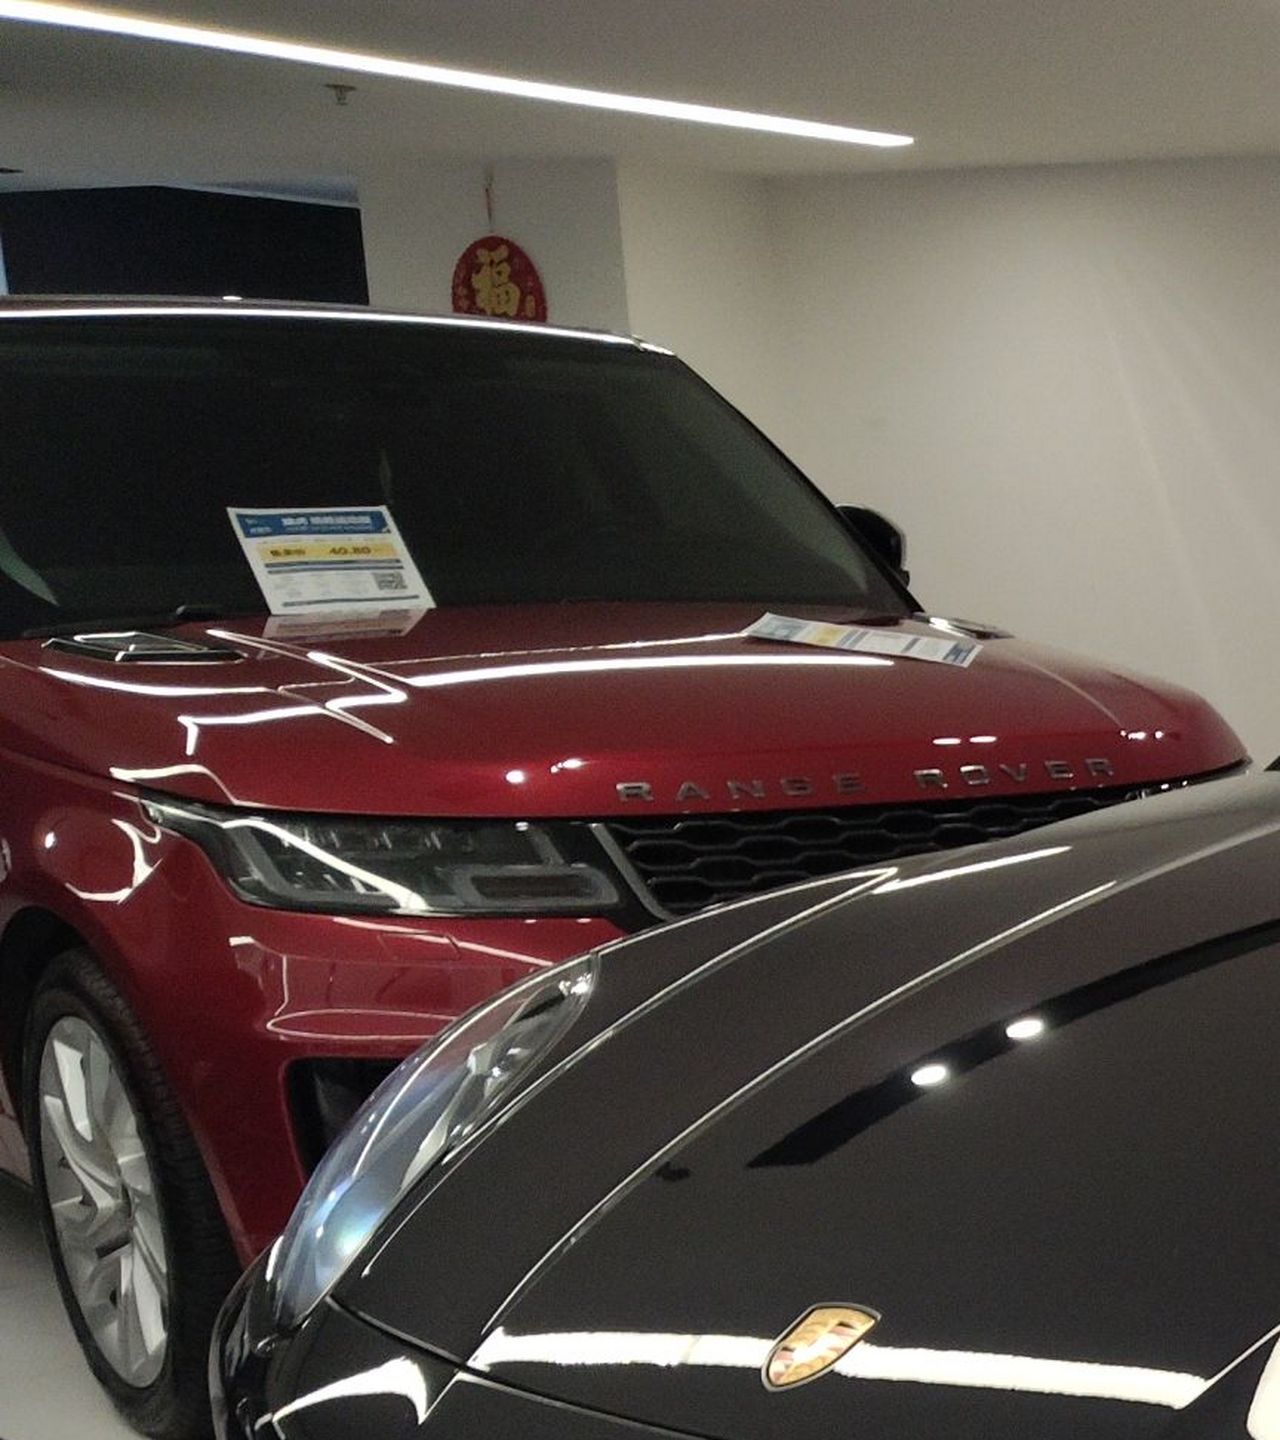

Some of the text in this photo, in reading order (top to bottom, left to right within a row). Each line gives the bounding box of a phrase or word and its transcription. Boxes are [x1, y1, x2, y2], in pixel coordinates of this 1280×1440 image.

[471, 244, 522, 317] 福
[615, 758, 1115, 801] RANGE ROVER
